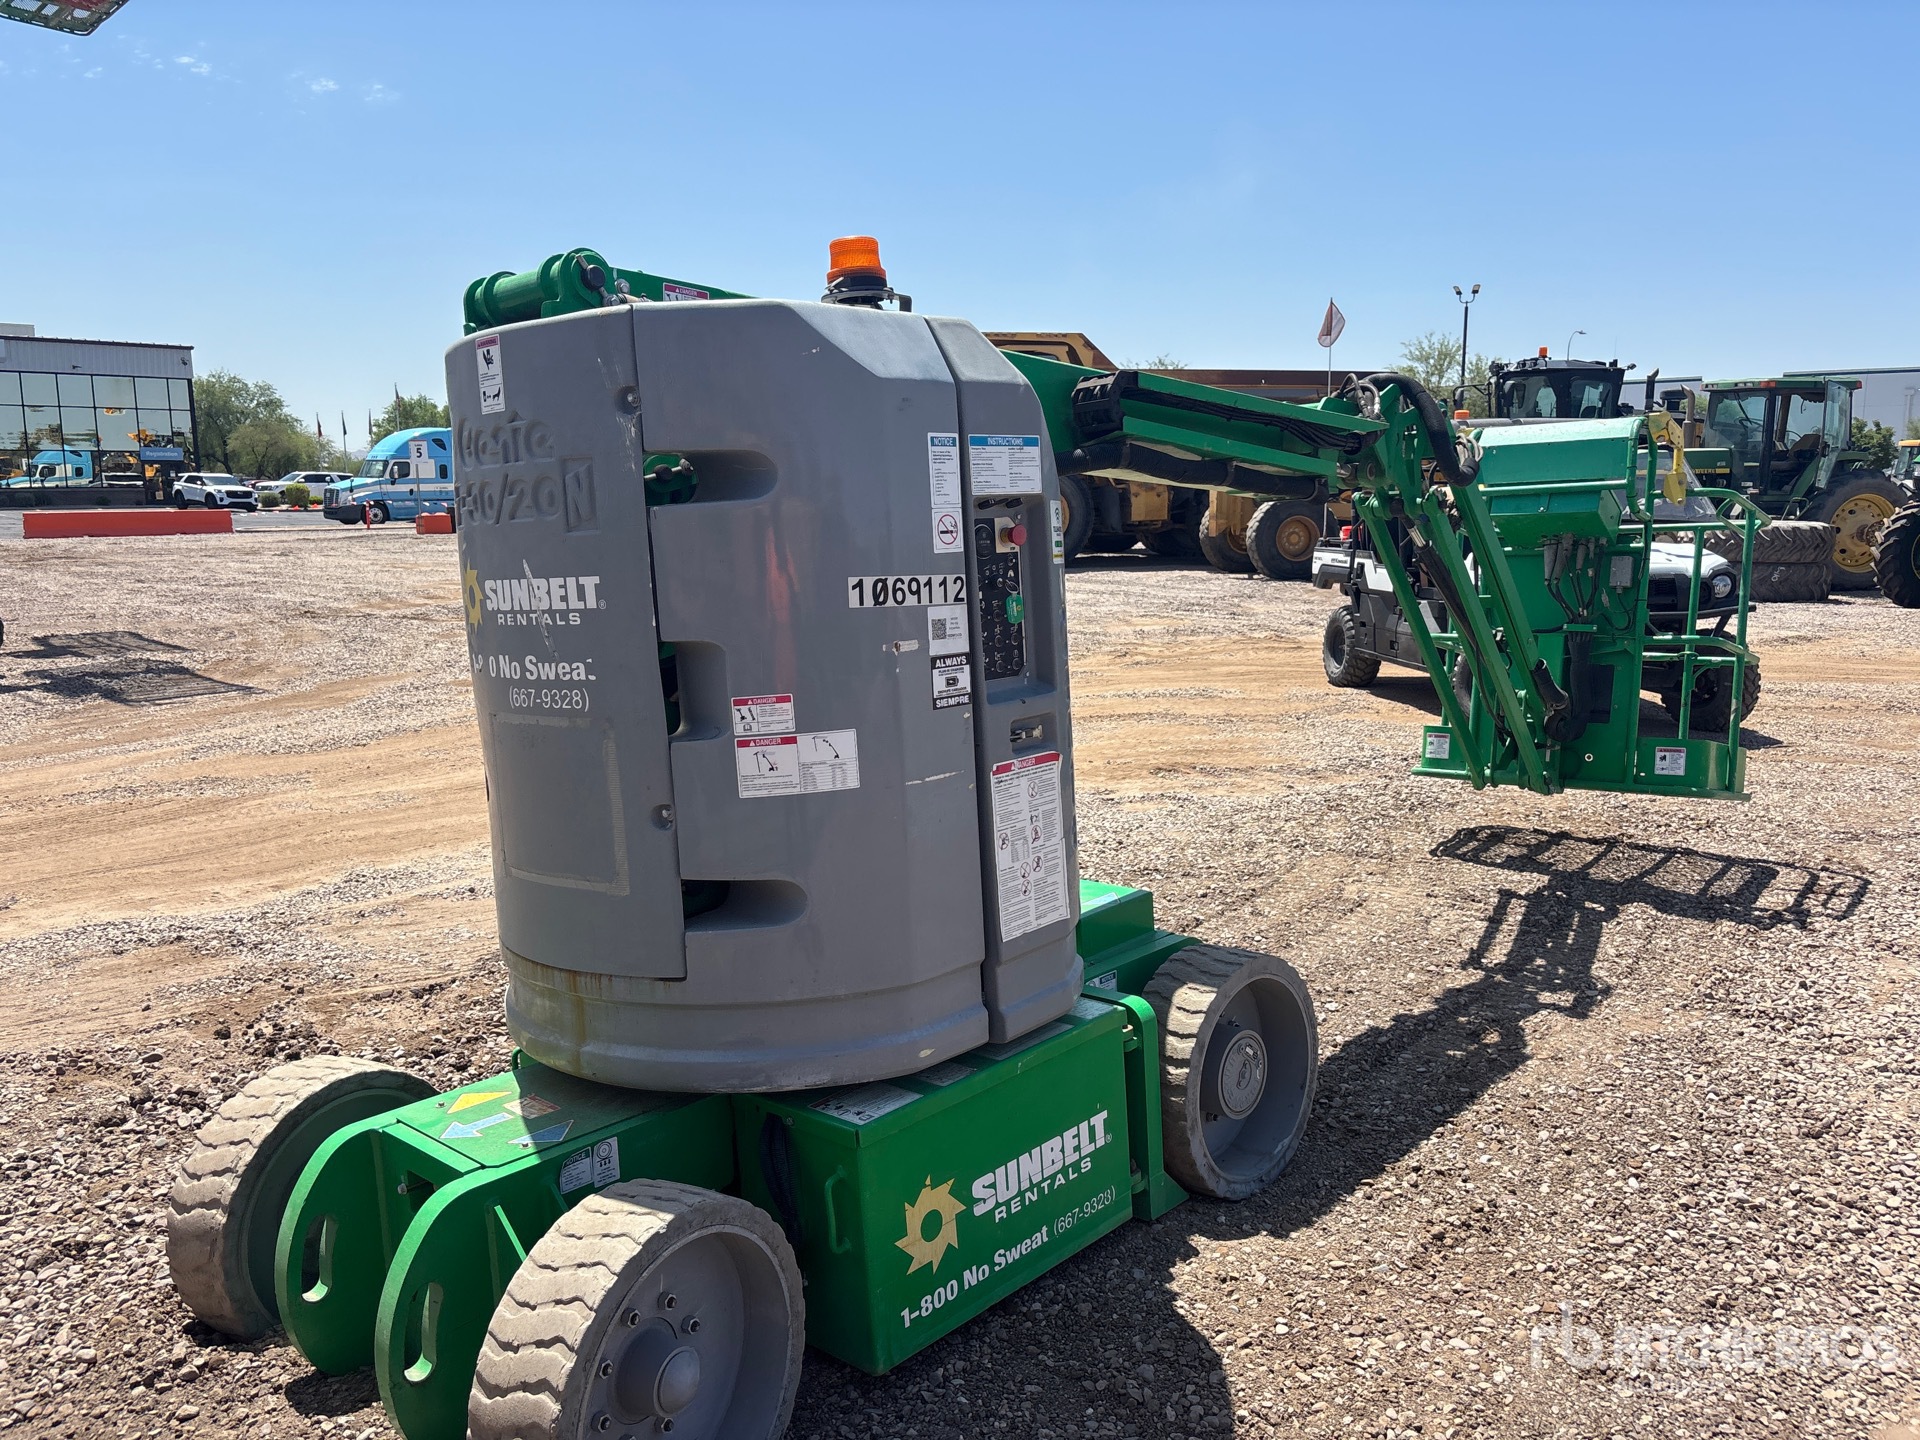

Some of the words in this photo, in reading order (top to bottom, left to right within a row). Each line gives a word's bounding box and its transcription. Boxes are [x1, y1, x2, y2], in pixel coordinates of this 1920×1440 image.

[933, 437, 954, 446] NOTICE
[987, 437, 1024, 446] INSTRUCTIONS
[416, 448, 422, 458] 5
[484, 575, 600, 611] SUNBELT
[497, 612, 581, 626] RENTALS
[498, 654, 521, 680] No
[935, 655, 967, 668] ALWAYS
[509, 685, 589, 712] (667-9328)
[753, 697, 777, 705] DANGER
[935, 695, 969, 708] SIEMPRE
[755, 738, 781, 746] DANGER
[971, 1109, 1108, 1217] SUNBELT
[994, 1157, 1092, 1224] RENTALS
[900, 1279, 958, 1329] 1-800
[963, 1264, 990, 1291] No
[993, 1224, 1049, 1273] Sweat
